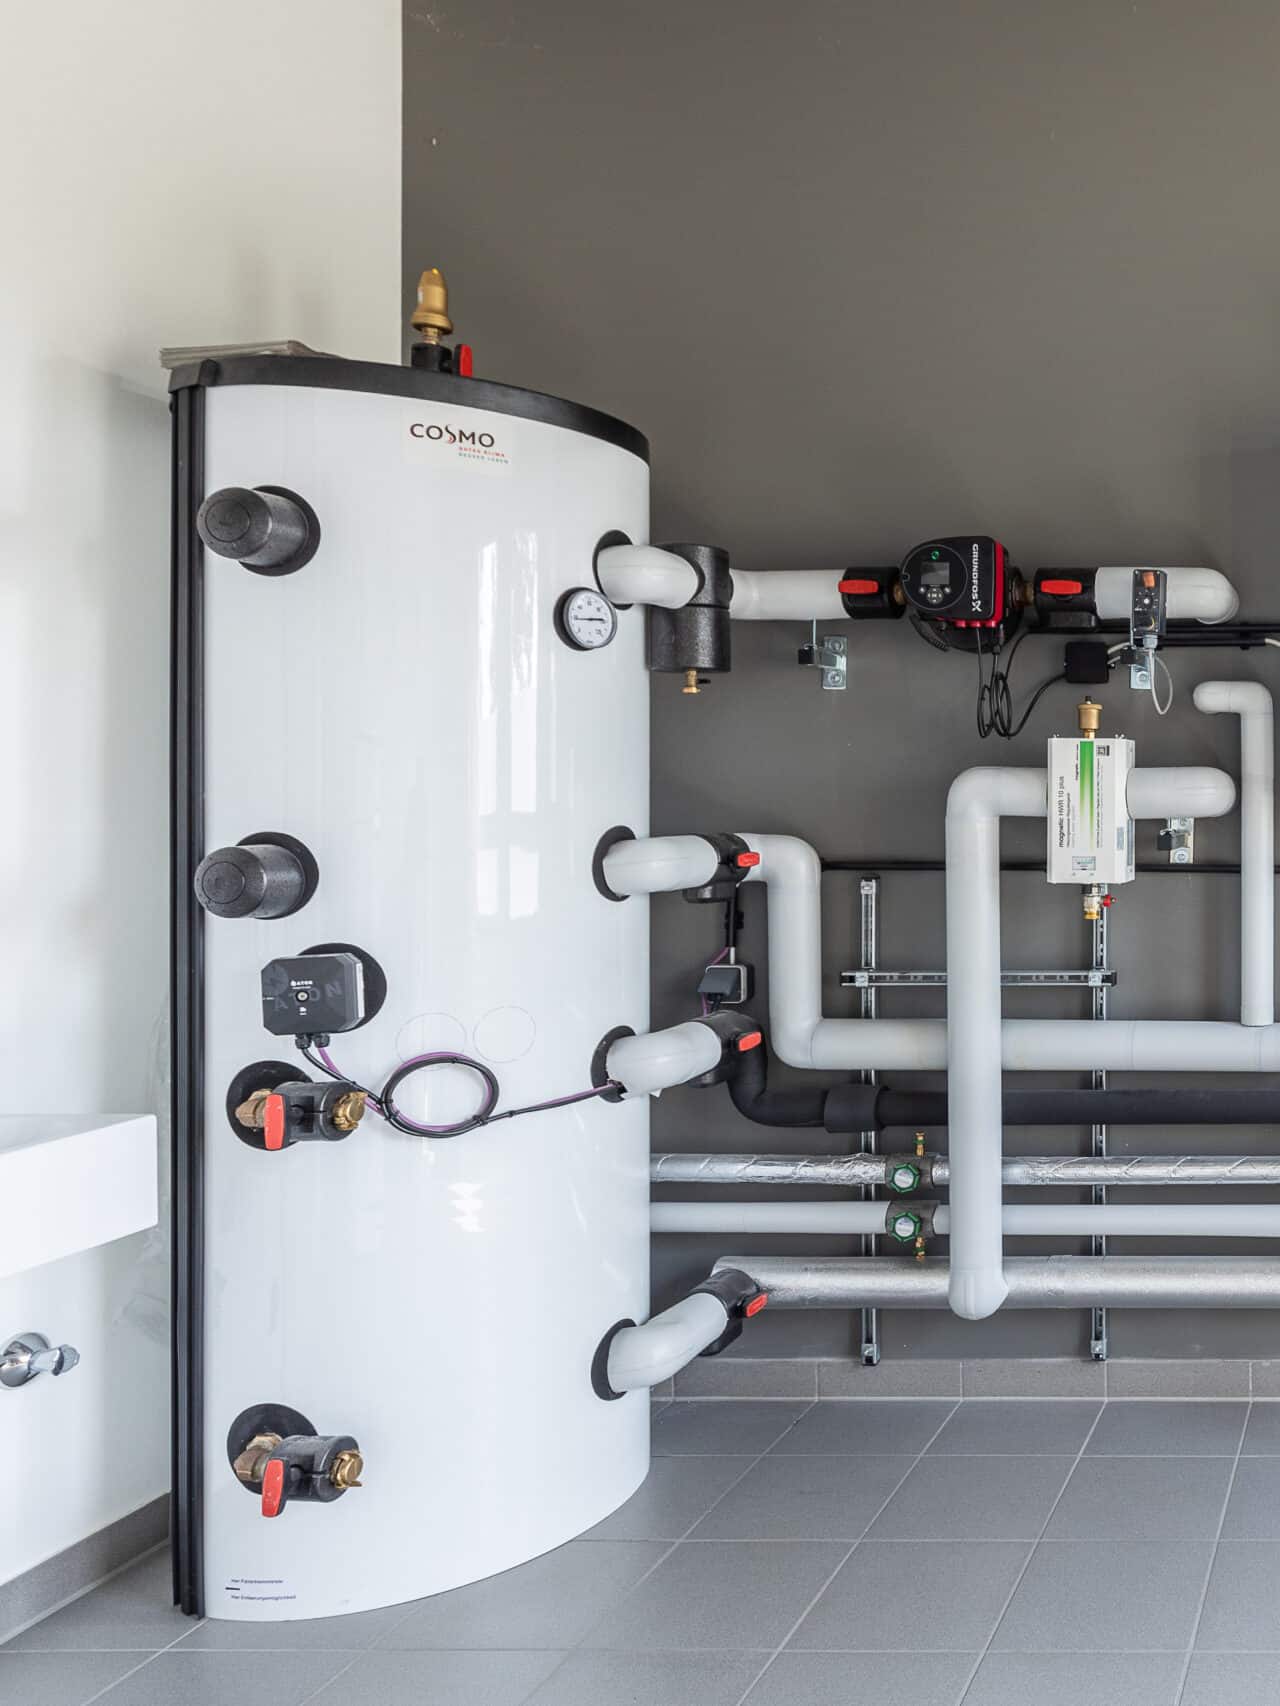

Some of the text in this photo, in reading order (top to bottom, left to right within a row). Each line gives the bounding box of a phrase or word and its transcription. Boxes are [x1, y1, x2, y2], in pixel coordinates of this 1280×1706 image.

[409, 423, 495, 448] COSMO
[971, 543, 979, 600] GRUNDFOS
[1058, 818, 1066, 848] magnetic
